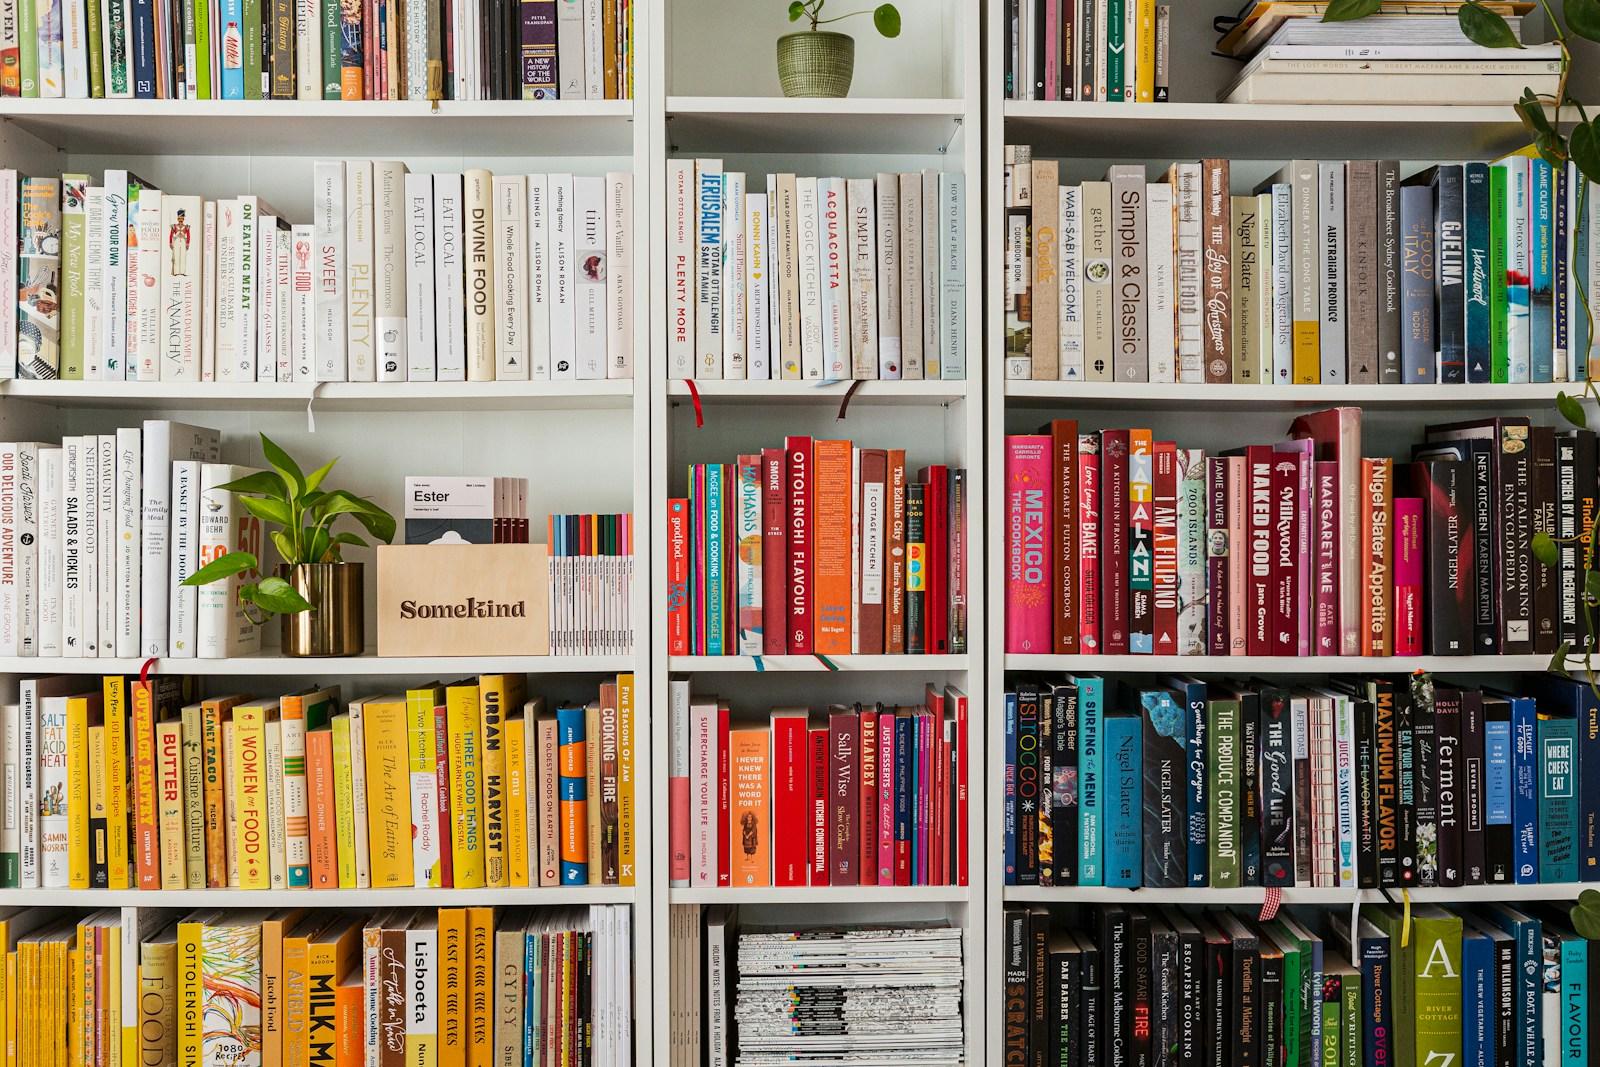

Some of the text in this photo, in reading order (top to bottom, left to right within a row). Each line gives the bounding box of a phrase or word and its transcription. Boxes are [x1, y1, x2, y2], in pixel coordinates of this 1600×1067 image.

[278, 3, 289, 50] in History
[328, 3, 337, 27] Food
[226, 36, 238, 64] Milk!
[702, 174, 720, 243] JERUSALEM
[1540, 164, 1548, 219] JAMIE OLIVER
[242, 204, 251, 309] ON EATING MEAT
[414, 197, 425, 267] EAT LOCAL
[506, 226, 514, 250] Whole
[585, 210, 600, 245] time
[701, 246, 709, 268] SAMI
[826, 191, 839, 289] ACQUACOTTA
[857, 207, 868, 260] SIMPLE
[1065, 190, 1075, 322] WABI-SABI WELCOME
[1212, 225, 1222, 244] THE
[1238, 212, 1255, 291] Nigel Slater
[1384, 170, 1395, 312] The Broadsheet Sydney Cookbook
[1441, 221, 1462, 286] GJELINA
[323, 246, 336, 295] SWEET
[472, 208, 486, 315] DIVINE FOOD
[506, 274, 514, 305] Cooking
[1117, 191, 1140, 354] Simple & Classic
[1212, 277, 1222, 289] OF
[167, 298, 183, 363] ANARCHY
[352, 264, 369, 347] PLENTY
[711, 280, 719, 334] OTTOLENGHI
[1207, 292, 1228, 355] Christmas
[102, 442, 111, 513] COMMUNITY
[414, 490, 450, 502] Ester
[894, 487, 902, 518] Edible
[1, 453, 14, 584] OUR DELICIOUS ADVENTURE
[67, 497, 78, 536] SALADS
[794, 452, 804, 615] OTTOLENGHI FLAVOUR
[893, 521, 902, 540] City
[1012, 491, 1021, 580] THE COOKBOOK
[1025, 490, 1043, 584] MEXICO
[1253, 463, 1270, 576] NAKED FOOD
[1277, 487, 1293, 566] Milkwood
[1369, 466, 1387, 632] Nigel Slater Appetite
[67, 549, 78, 589] PICKLES
[603, 708, 615, 802] COOKING FIRE
[863, 722, 874, 786] DELANCEY
[1547, 746, 1569, 758] WHERE
[1589, 708, 1598, 740] trullo
[164, 734, 177, 800] BUTTER
[242, 736, 257, 793] WOMEN
[485, 692, 502, 852] URBAN HARVEST
[834, 733, 850, 796] Sally Wise
[1218, 710, 1235, 864] THE PRODUCE COMPANION
[1377, 693, 1394, 850] MAXIMUM FLAVOR
[1439, 736, 1457, 826] ferment
[1548, 762, 1569, 774] CHEFS
[1552, 777, 1564, 790] EAT
[244, 810, 259, 853] FOOD
[383, 757, 398, 860] The Art of Eating
[816, 800, 824, 872] KITCHEN CONFIDENTIAL
[186, 943, 196, 1036] OTTOLENGHI
[266, 974, 276, 1032] Jacob Food
[415, 942, 428, 1023] Lisboeta
[447, 928, 458, 1046] FEAST FOR THE EYES
[504, 965, 517, 1028] GYPSY
[1135, 938, 1148, 1036] FOOD SAFARI FIRE
[1312, 972, 1322, 1035] kylie kwong
[1569, 984, 1581, 1058] FLAVOUR
